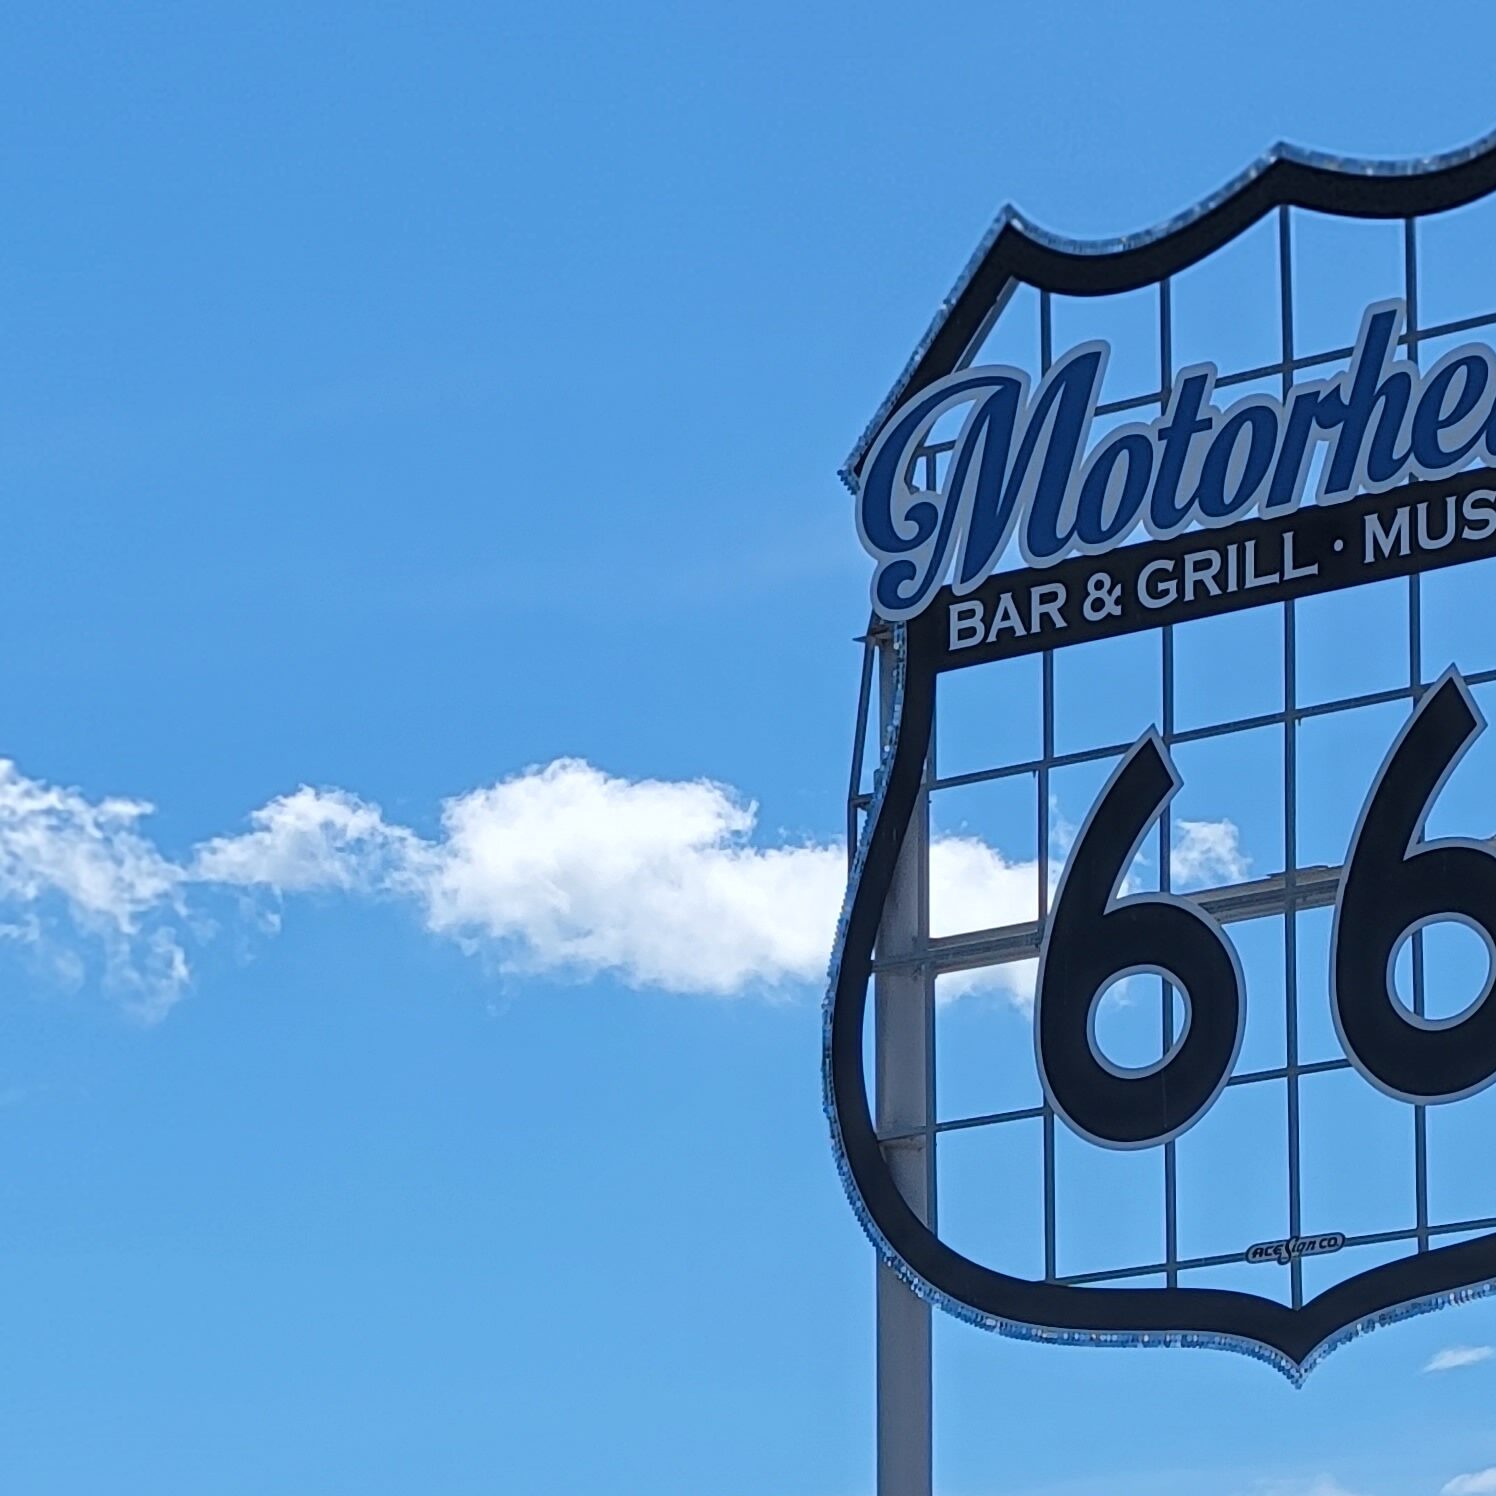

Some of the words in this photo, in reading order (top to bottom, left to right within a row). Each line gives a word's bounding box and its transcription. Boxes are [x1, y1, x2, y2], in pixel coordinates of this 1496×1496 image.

[949, 583, 1067, 651] BAR
[1083, 573, 1121, 621] &
[1137, 531, 1319, 609] GRILL
